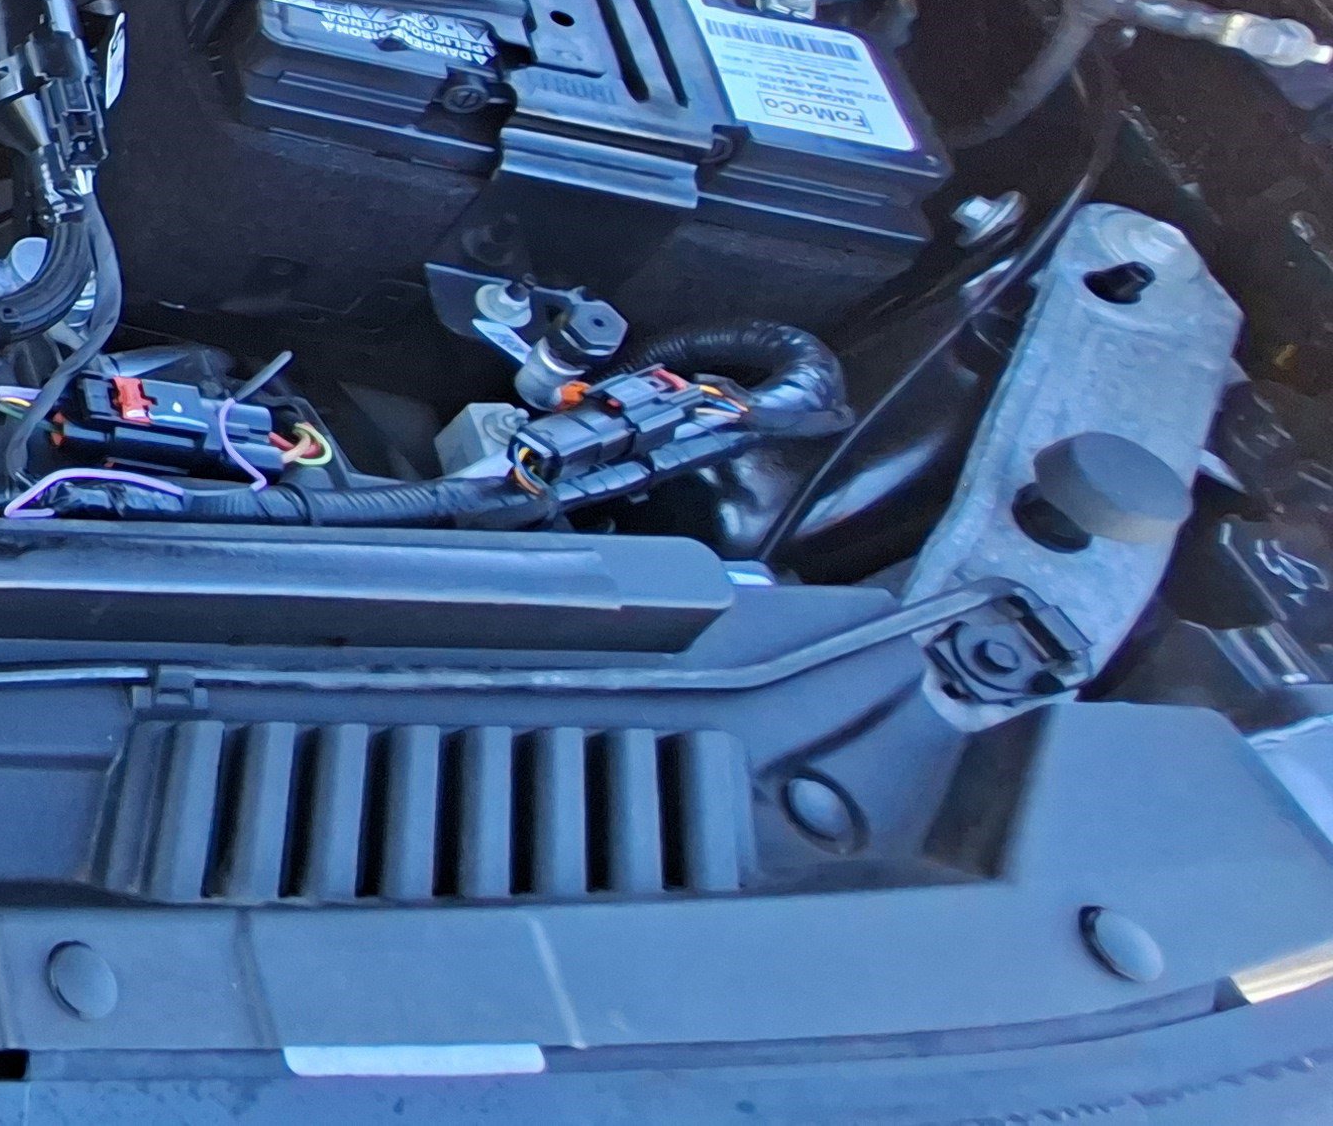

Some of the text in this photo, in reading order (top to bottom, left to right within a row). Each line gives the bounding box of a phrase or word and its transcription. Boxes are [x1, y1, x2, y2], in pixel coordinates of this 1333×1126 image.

[336, 25, 473, 62] DANGER POISON
[764, 97, 867, 129] FoMoCo
